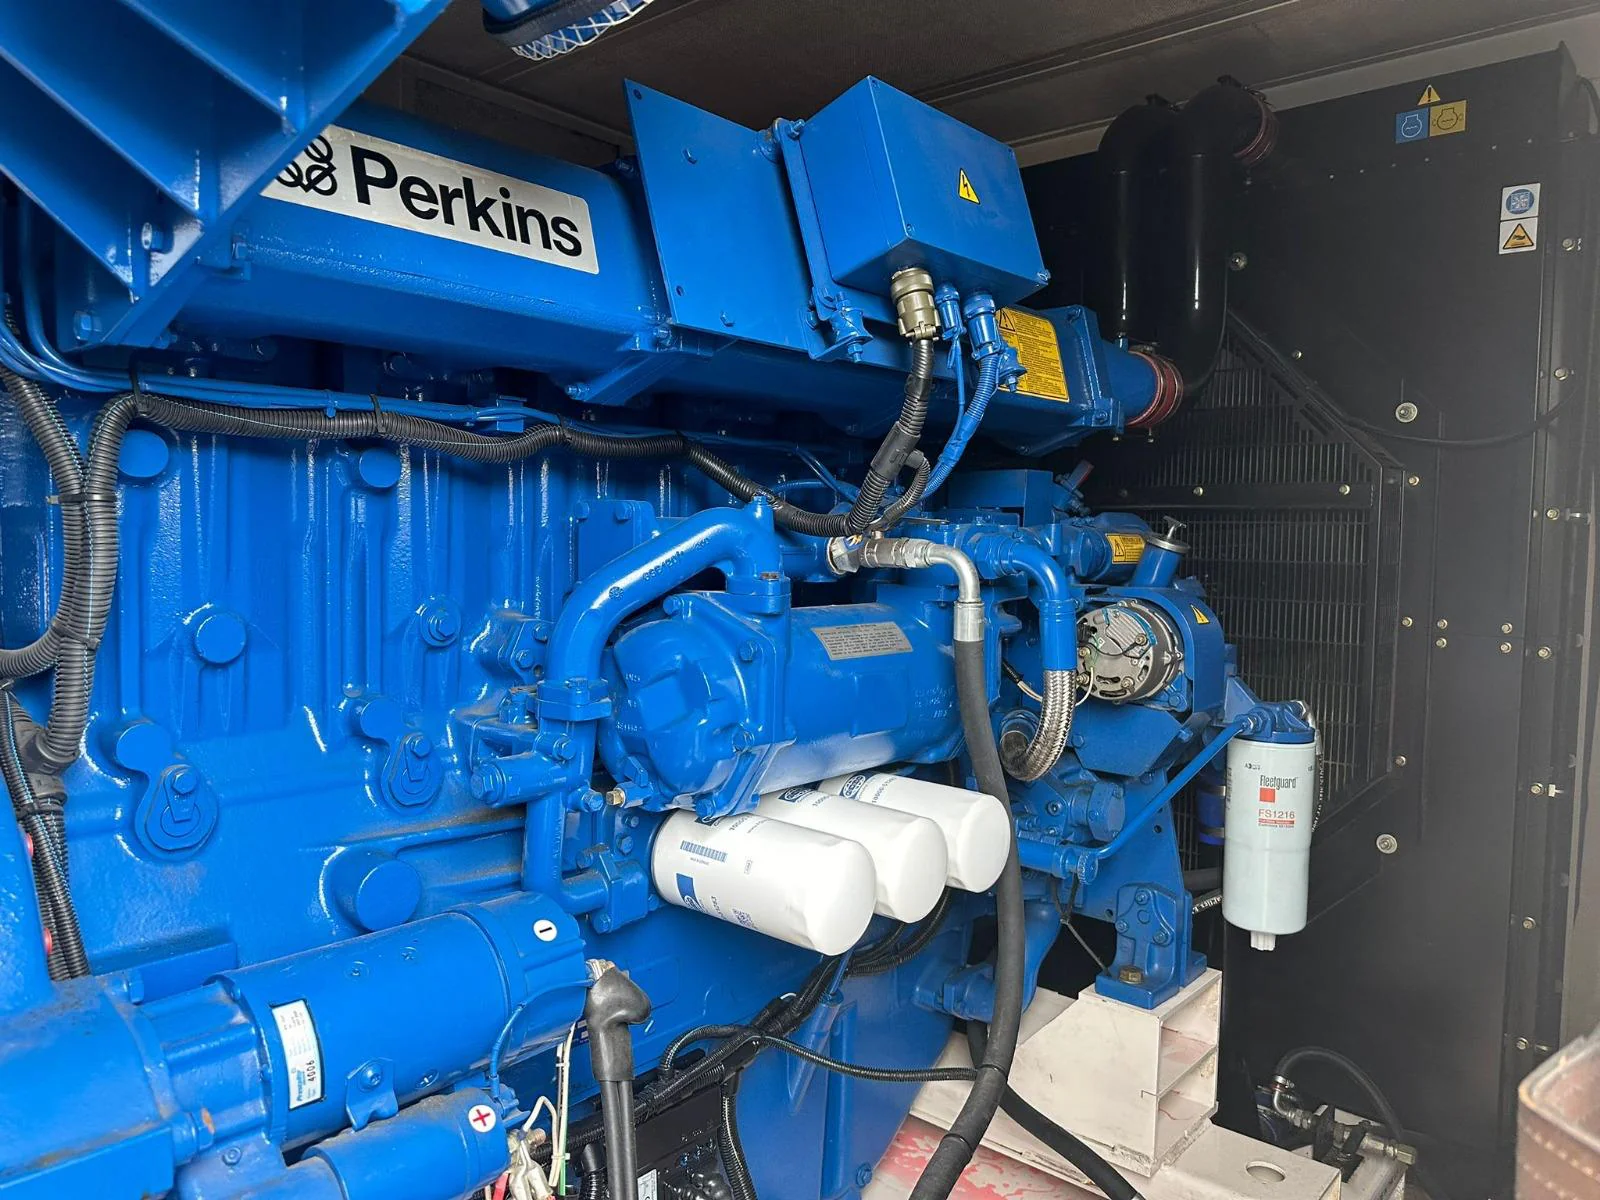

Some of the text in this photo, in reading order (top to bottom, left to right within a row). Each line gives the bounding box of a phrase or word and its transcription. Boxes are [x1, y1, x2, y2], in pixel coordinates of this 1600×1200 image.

[350, 145, 583, 257] Perkins
[1259, 775, 1296, 790] Fleetguard
[1258, 808, 1295, 819] FS1216
[306, 1060, 317, 1081] 4006
